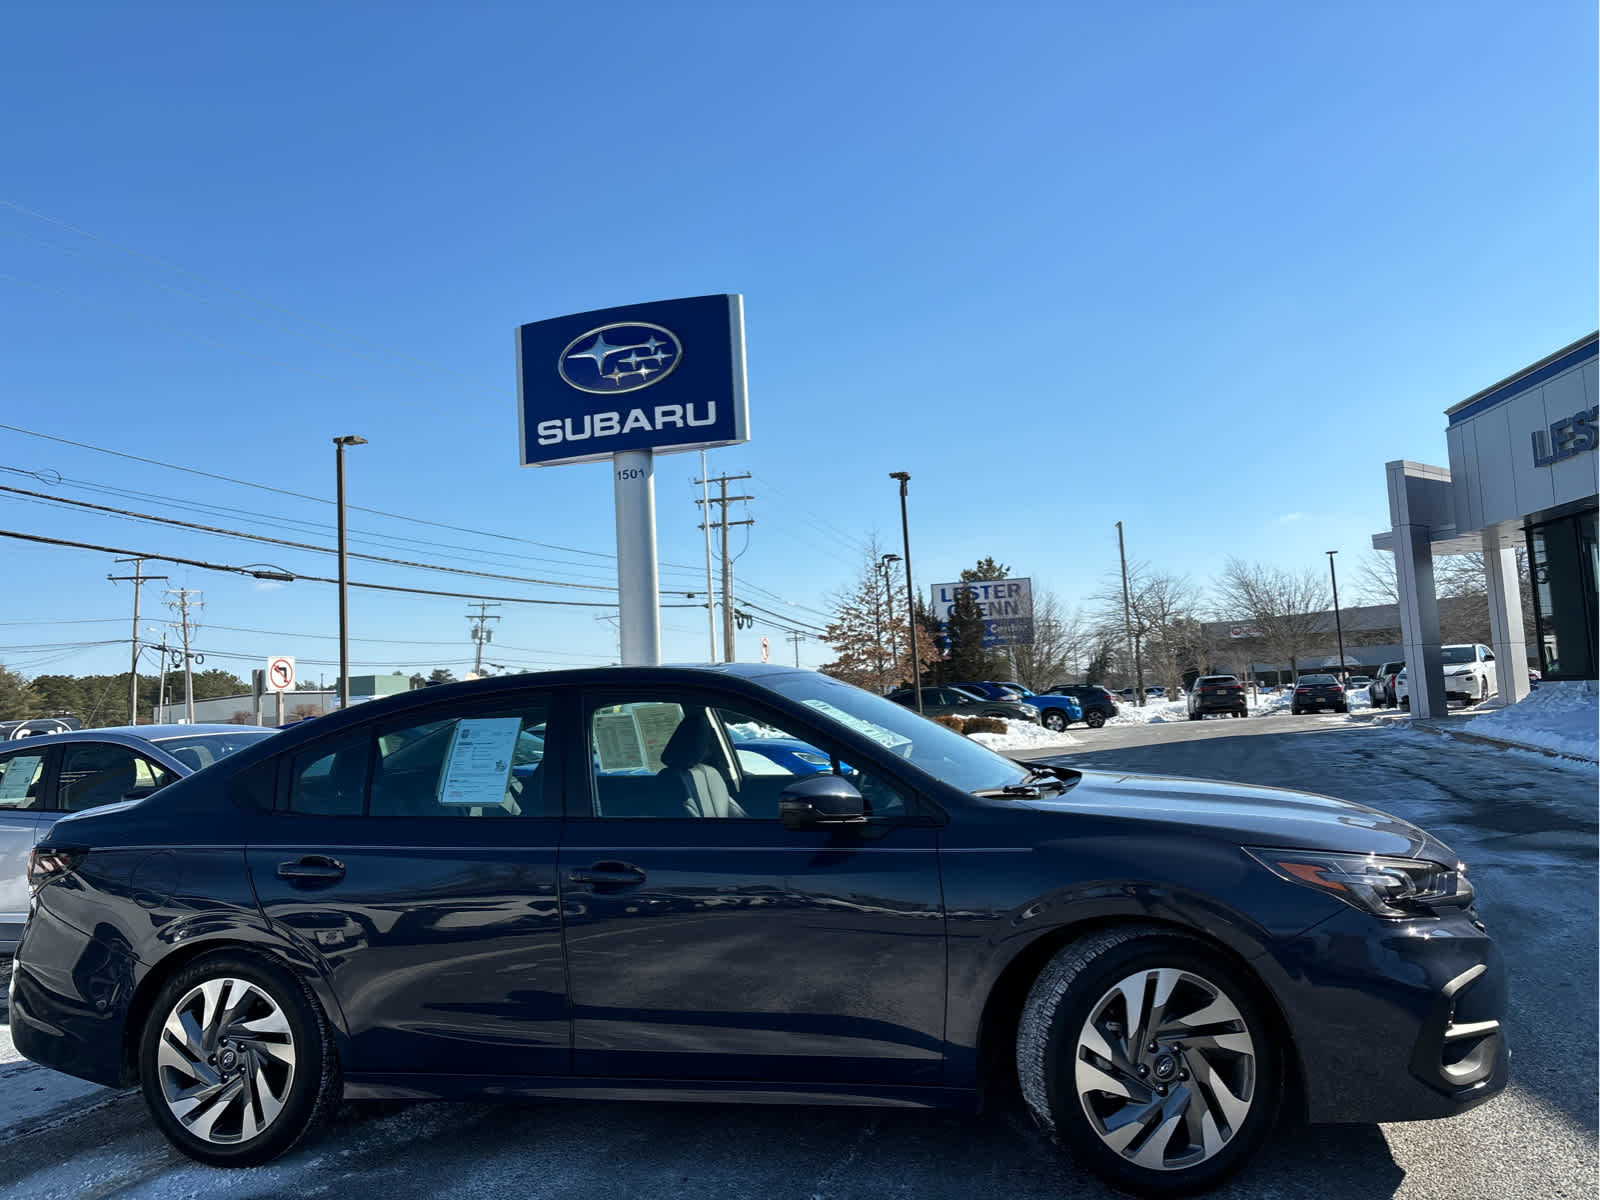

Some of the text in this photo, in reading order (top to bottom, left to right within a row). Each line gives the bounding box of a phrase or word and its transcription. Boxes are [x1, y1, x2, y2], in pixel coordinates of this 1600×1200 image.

[537, 401, 717, 446] SUBARU
[617, 469, 645, 480] 1501
[941, 583, 1021, 602] LESTER
[947, 600, 1019, 617] ENN
